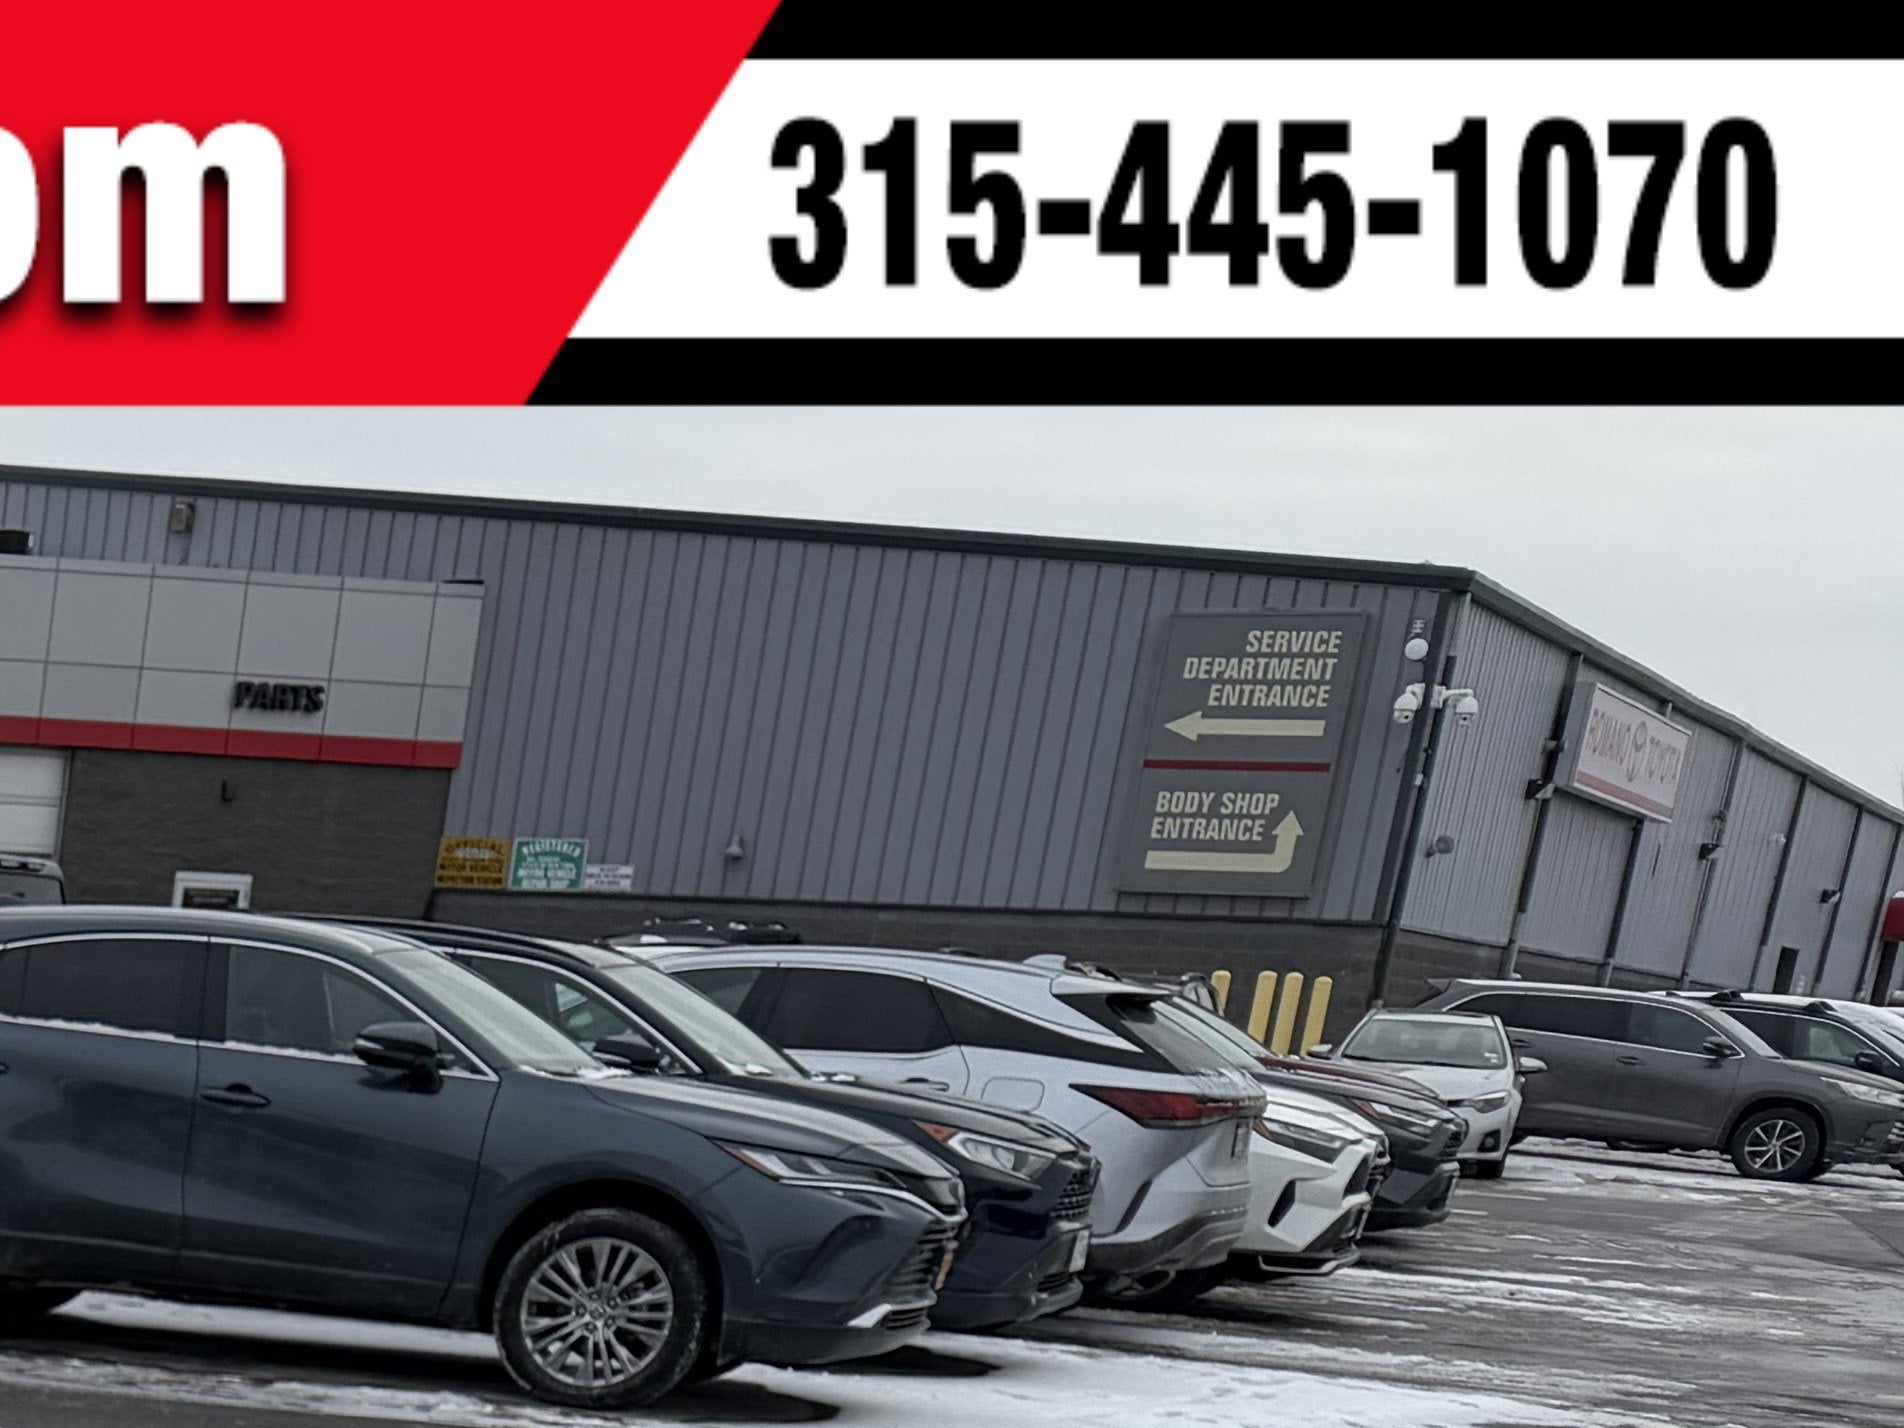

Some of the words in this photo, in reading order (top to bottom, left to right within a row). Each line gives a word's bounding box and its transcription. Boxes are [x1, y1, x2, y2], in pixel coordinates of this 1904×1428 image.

[1246, 630, 1342, 653] SERVICE
[1183, 657, 1338, 680] DEPARTMENT
[234, 681, 325, 713] PARTS
[1208, 684, 1331, 708] ENTRANCE
[1155, 791, 1215, 814] BODY
[1220, 792, 1280, 815] SHOP
[1150, 817, 1266, 841] ENTRANCE
